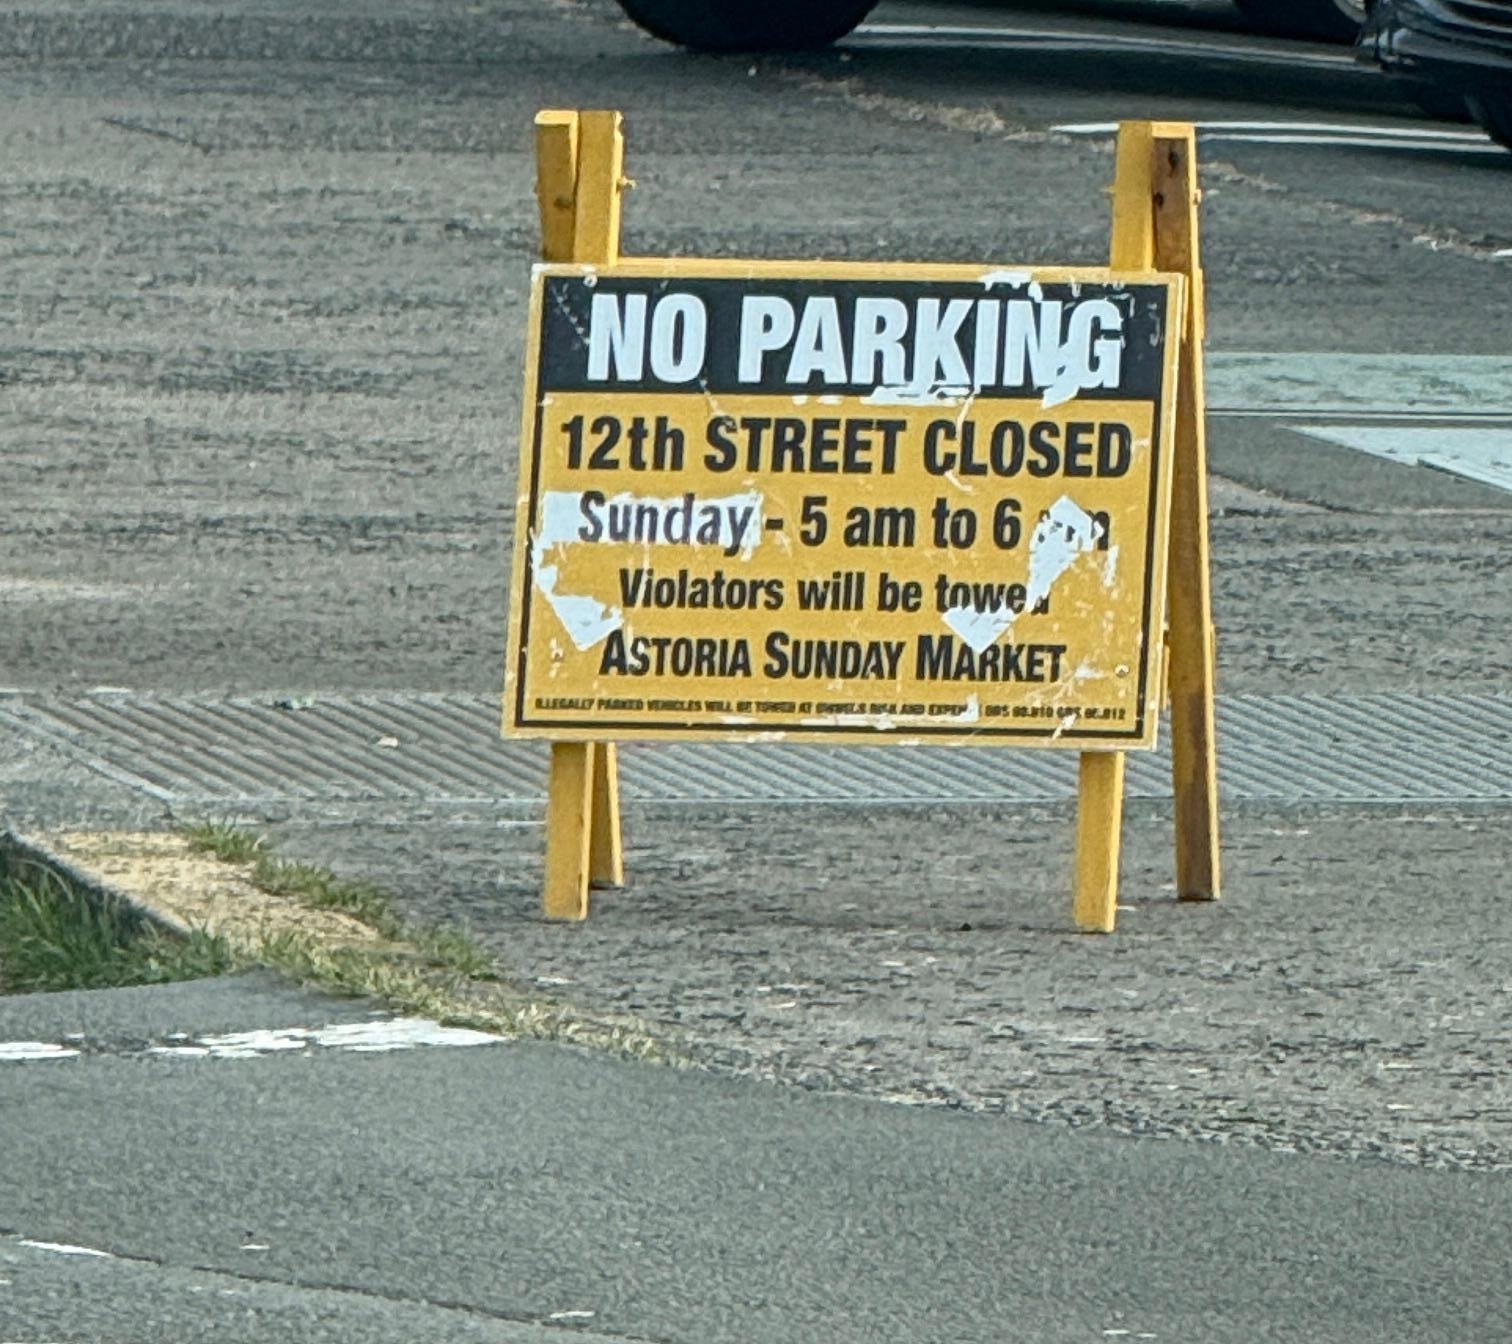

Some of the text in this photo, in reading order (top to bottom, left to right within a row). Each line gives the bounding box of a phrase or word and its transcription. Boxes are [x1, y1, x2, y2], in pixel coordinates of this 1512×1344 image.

[587, 292, 1122, 390] NO PARKING
[561, 414, 1132, 479] 12th STREET CLOSED
[578, 490, 755, 557] Sunday
[800, 496, 828, 547] 5
[843, 506, 916, 549] am
[932, 498, 977, 550] to
[993, 498, 1022, 551] 6
[619, 568, 785, 611] Violators
[797, 571, 866, 612] will
[877, 573, 923, 613] be
[599, 629, 1067, 683] ASTORIA SUNDAY MARKET
